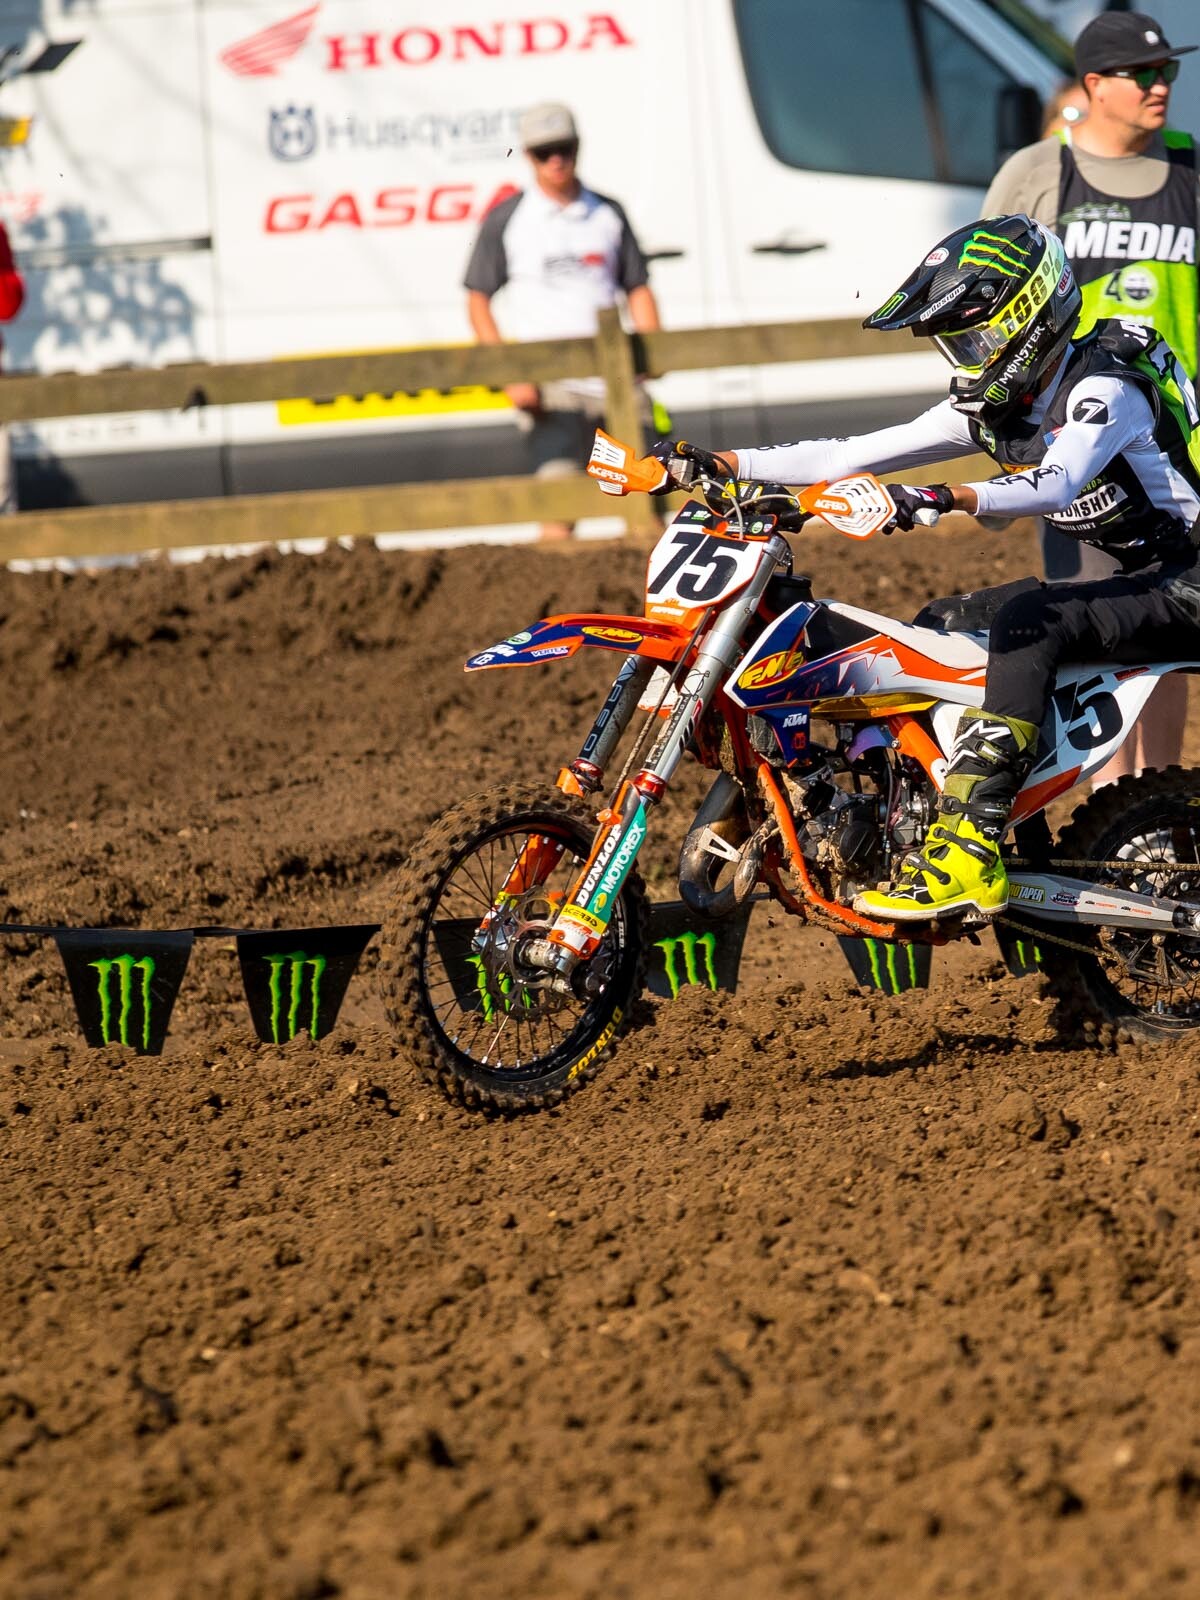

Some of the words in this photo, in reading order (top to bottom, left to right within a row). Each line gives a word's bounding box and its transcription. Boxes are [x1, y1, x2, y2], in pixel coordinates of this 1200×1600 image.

[325, 14, 634, 72] HONDA
[326, 106, 521, 150] Husqvar
[263, 182, 522, 235] GASGA
[927, 251, 945, 263] BELL
[1064, 221, 1195, 264] MEDIA
[1059, 266, 1072, 295] BELL
[1001, 325, 1045, 384] MONSTER
[648, 531, 750, 602] 75
[783, 713, 808, 728] KTM
[577, 823, 625, 908] DUNLOP
[601, 823, 647, 896] MOTOREX
